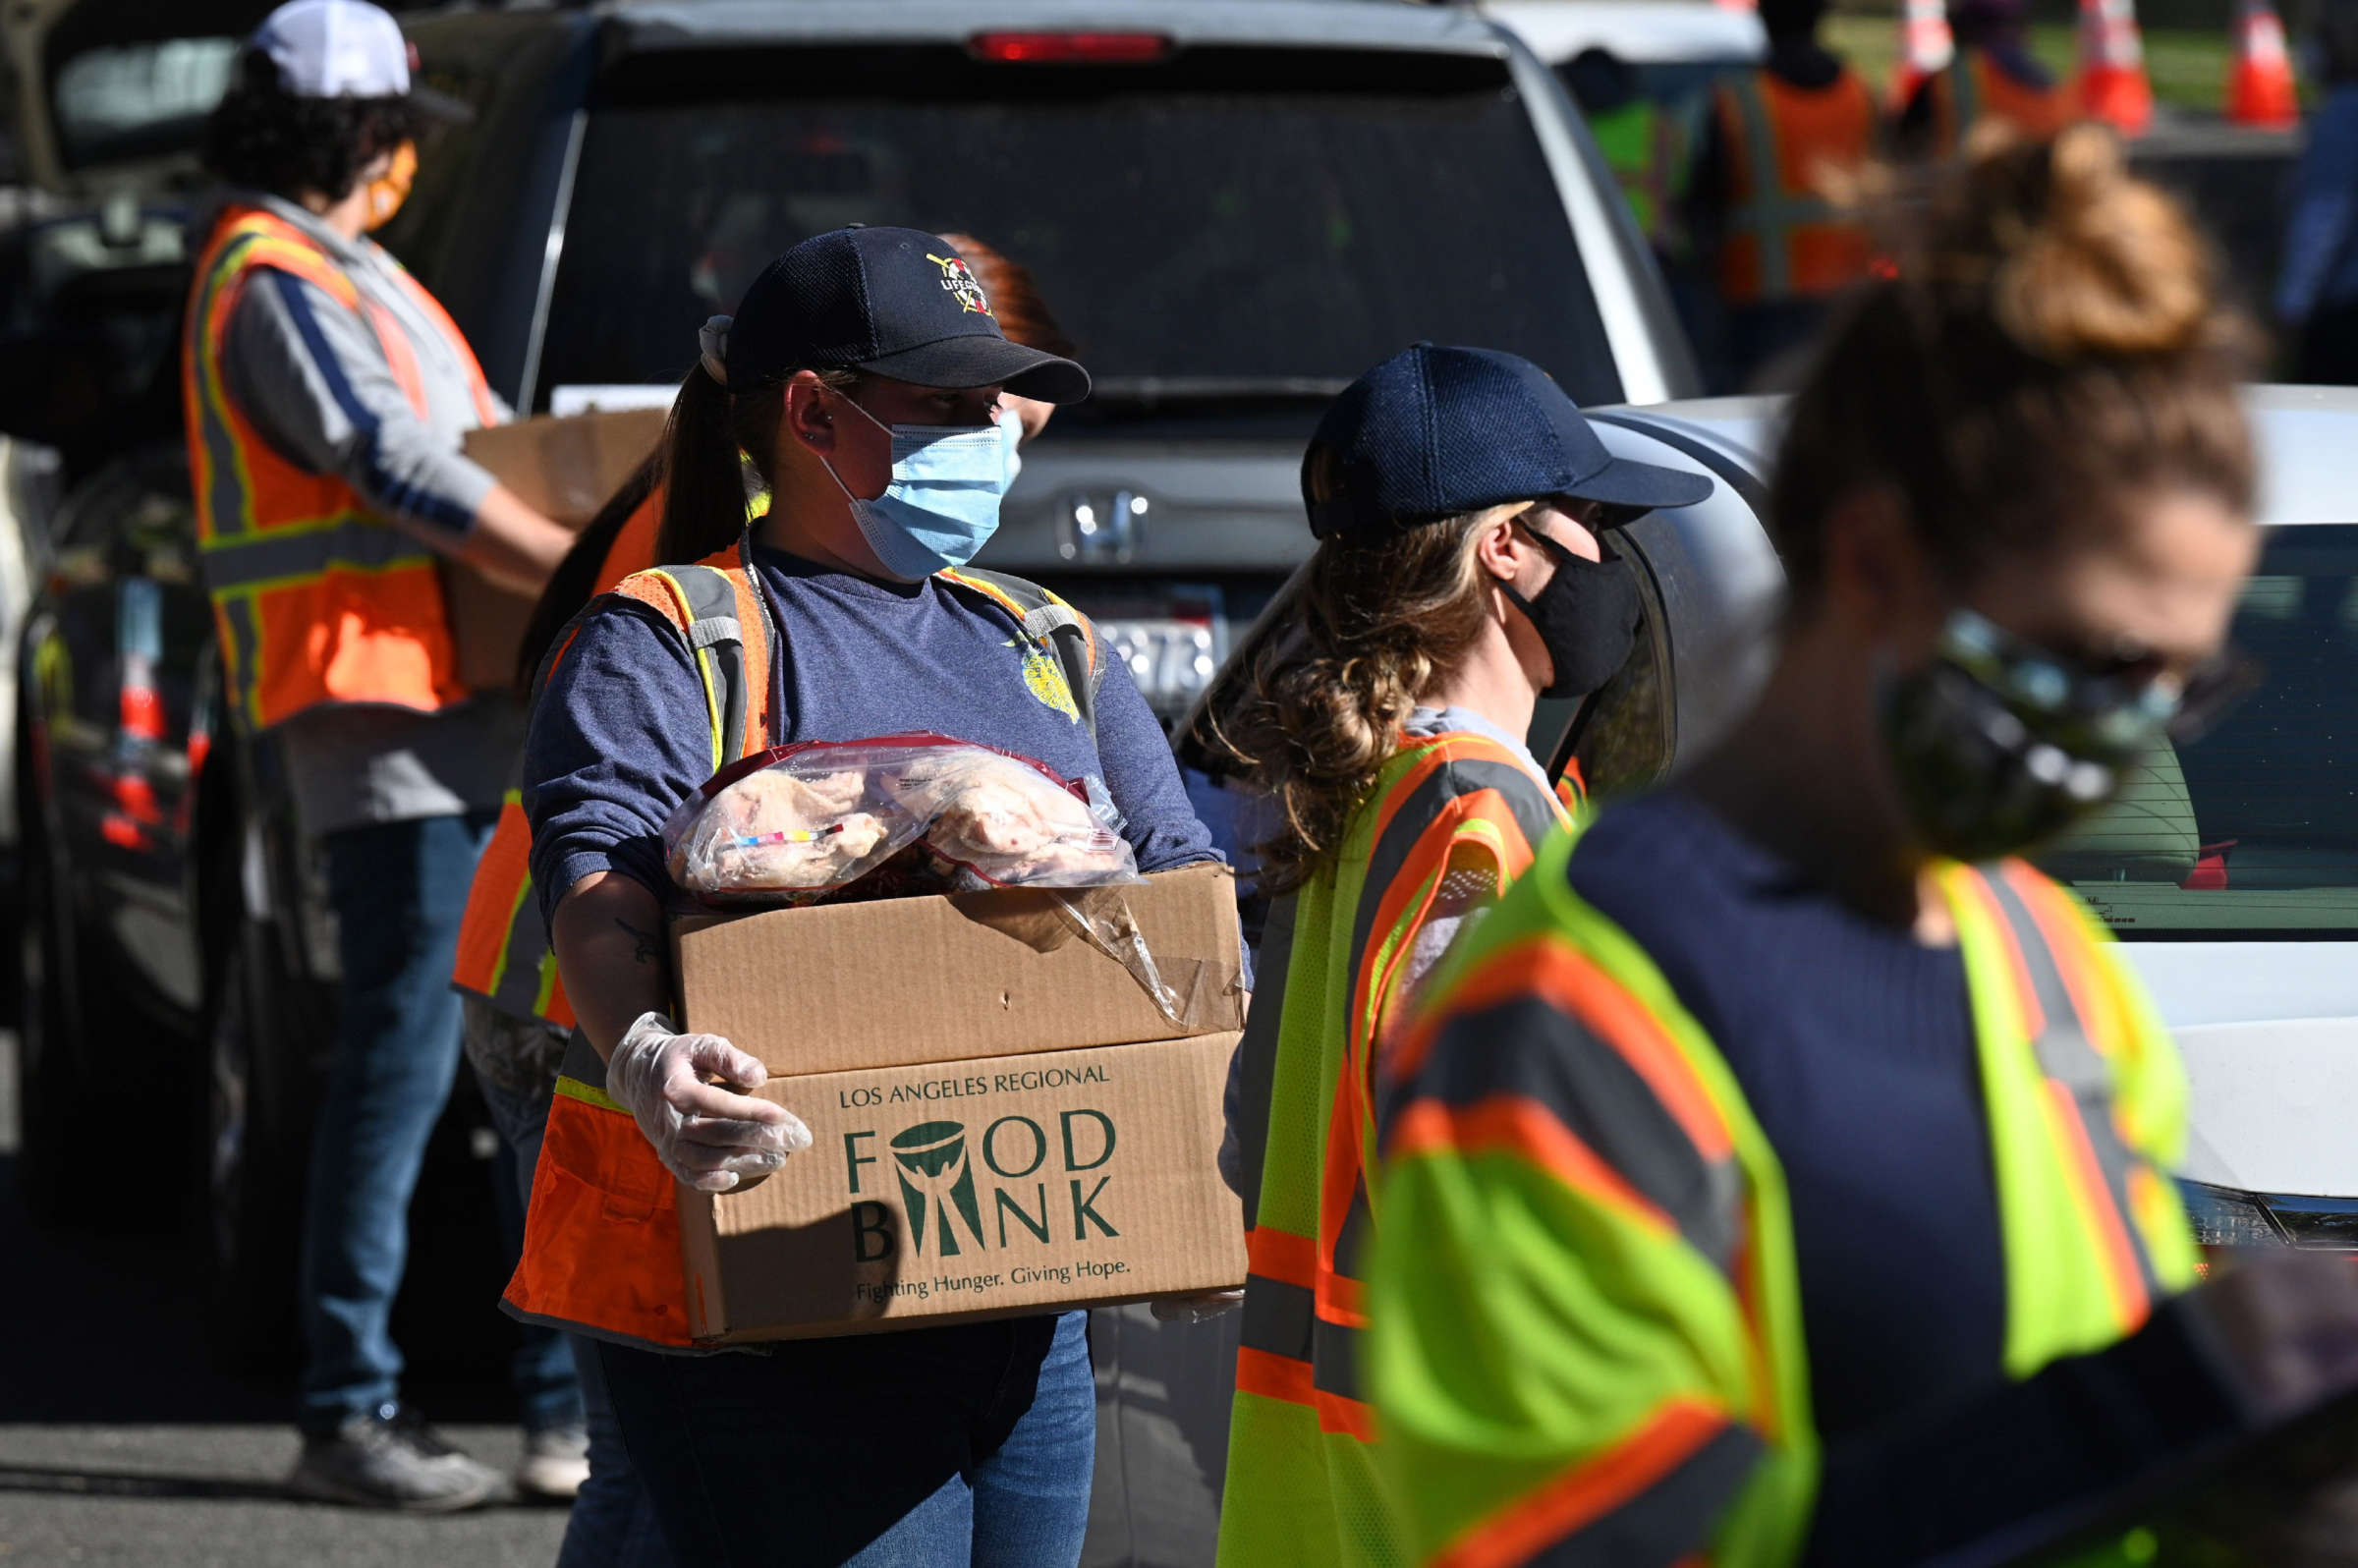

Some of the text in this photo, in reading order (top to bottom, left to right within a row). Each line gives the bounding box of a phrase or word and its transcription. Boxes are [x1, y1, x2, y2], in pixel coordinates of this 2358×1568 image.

[840, 1064, 1111, 1109] LOS ANGELES REGIONAL
[856, 1260, 1131, 1303] Fighting Hunger. Giving Hope.
